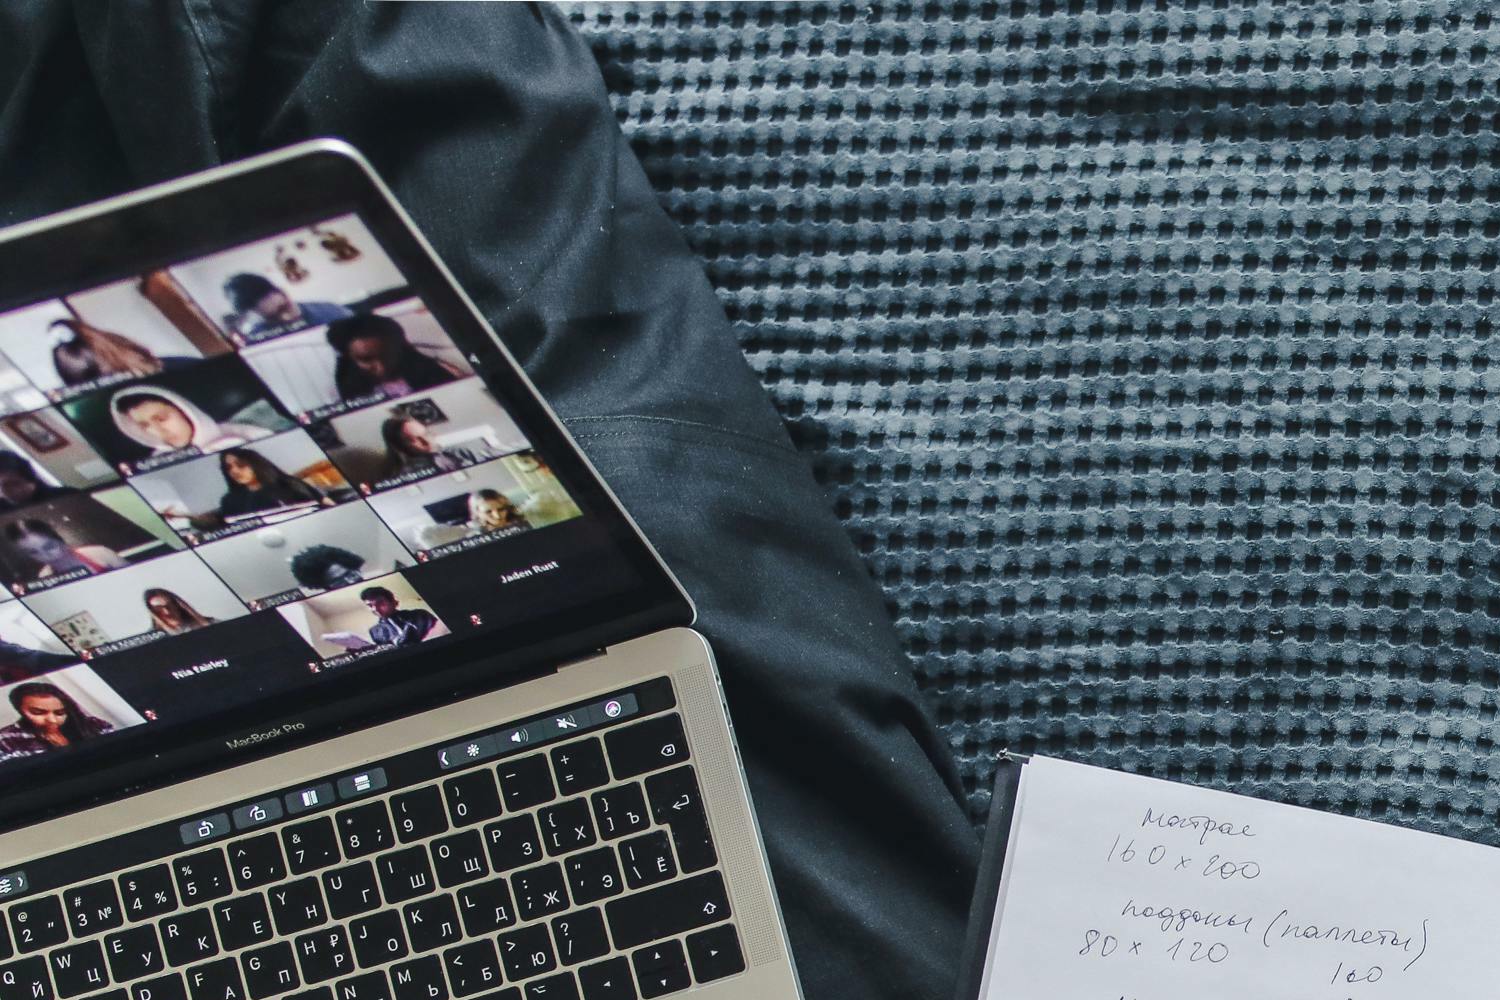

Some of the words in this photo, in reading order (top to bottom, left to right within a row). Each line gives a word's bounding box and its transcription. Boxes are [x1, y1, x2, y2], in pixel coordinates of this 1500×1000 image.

[500, 570, 533, 583] Jaden
[533, 560, 558, 572] Rust
[226, 728, 281, 750] MacBook
[278, 721, 304, 735] Pro
[627, 812, 639, 824] Ъ
[492, 830, 501, 843] P
[575, 826, 586, 840] Х
[439, 845, 449, 858] O
[522, 842, 532, 855] З
[1108, 834, 1166, 864] 160
[1203, 855, 1260, 879] 200
[389, 862, 393, 873] I
[464, 858, 481, 872] Щ
[657, 857, 667, 872] Ё
[331, 877, 342, 889] U
[410, 873, 425, 888] Ш
[603, 875, 612, 887] Э
[277, 892, 285, 905] Y
[362, 889, 369, 902] Г
[465, 896, 475, 907] L
[544, 891, 559, 906] Ж
[222, 908, 231, 921] T
[306, 905, 317, 918] Н
[411, 910, 422, 923] K
[496, 907, 508, 923] Д
[168, 924, 179, 937] R
[253, 921, 263, 934] Е
[360, 926, 367, 938] J
[442, 922, 452, 936] Л
[113, 940, 123, 953] E
[198, 936, 209, 950] К
[304, 941, 316, 955] H
[388, 939, 398, 951] О
[1079, 930, 1117, 957] 80
[1167, 938, 1228, 963] 120
[57, 954, 70, 968] W
[142, 952, 151, 966] У
[250, 958, 260, 970] G
[335, 954, 343, 967] Р
[532, 952, 545, 966] Ю
[3, 971, 15, 984] Q
[87, 968, 101, 982] Ц
[195, 973, 203, 986] F
[279, 970, 290, 983] П
[398, 969, 411, 984] M
[482, 967, 492, 980] Б
[32, 981, 43, 998] Й
[226, 986, 235, 999] А
[345, 986, 356, 999] N
[428, 984, 438, 996] Ь
